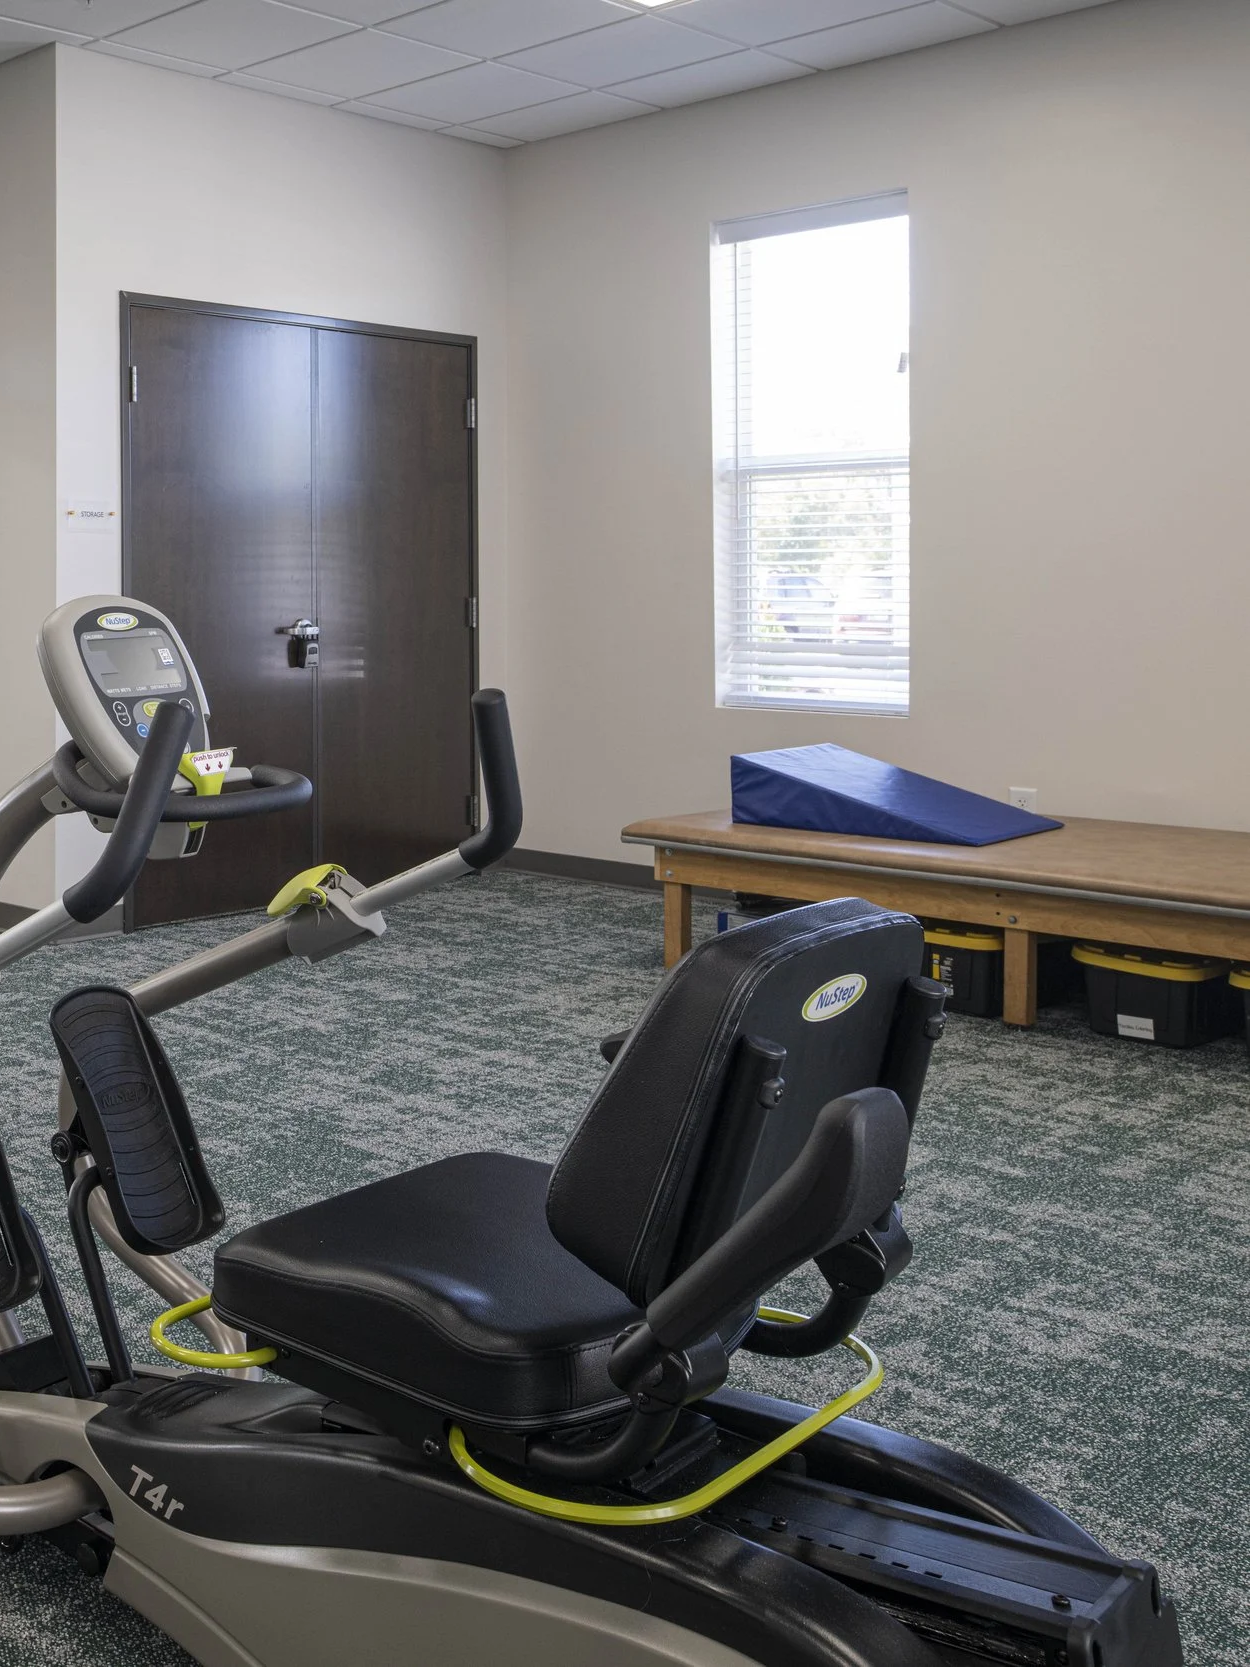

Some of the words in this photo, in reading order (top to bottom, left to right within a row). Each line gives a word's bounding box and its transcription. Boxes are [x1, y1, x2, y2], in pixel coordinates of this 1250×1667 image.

[105, 617, 131, 626] NuStep
[815, 985, 856, 1011] NuStep
[129, 1464, 185, 1520] T4r
